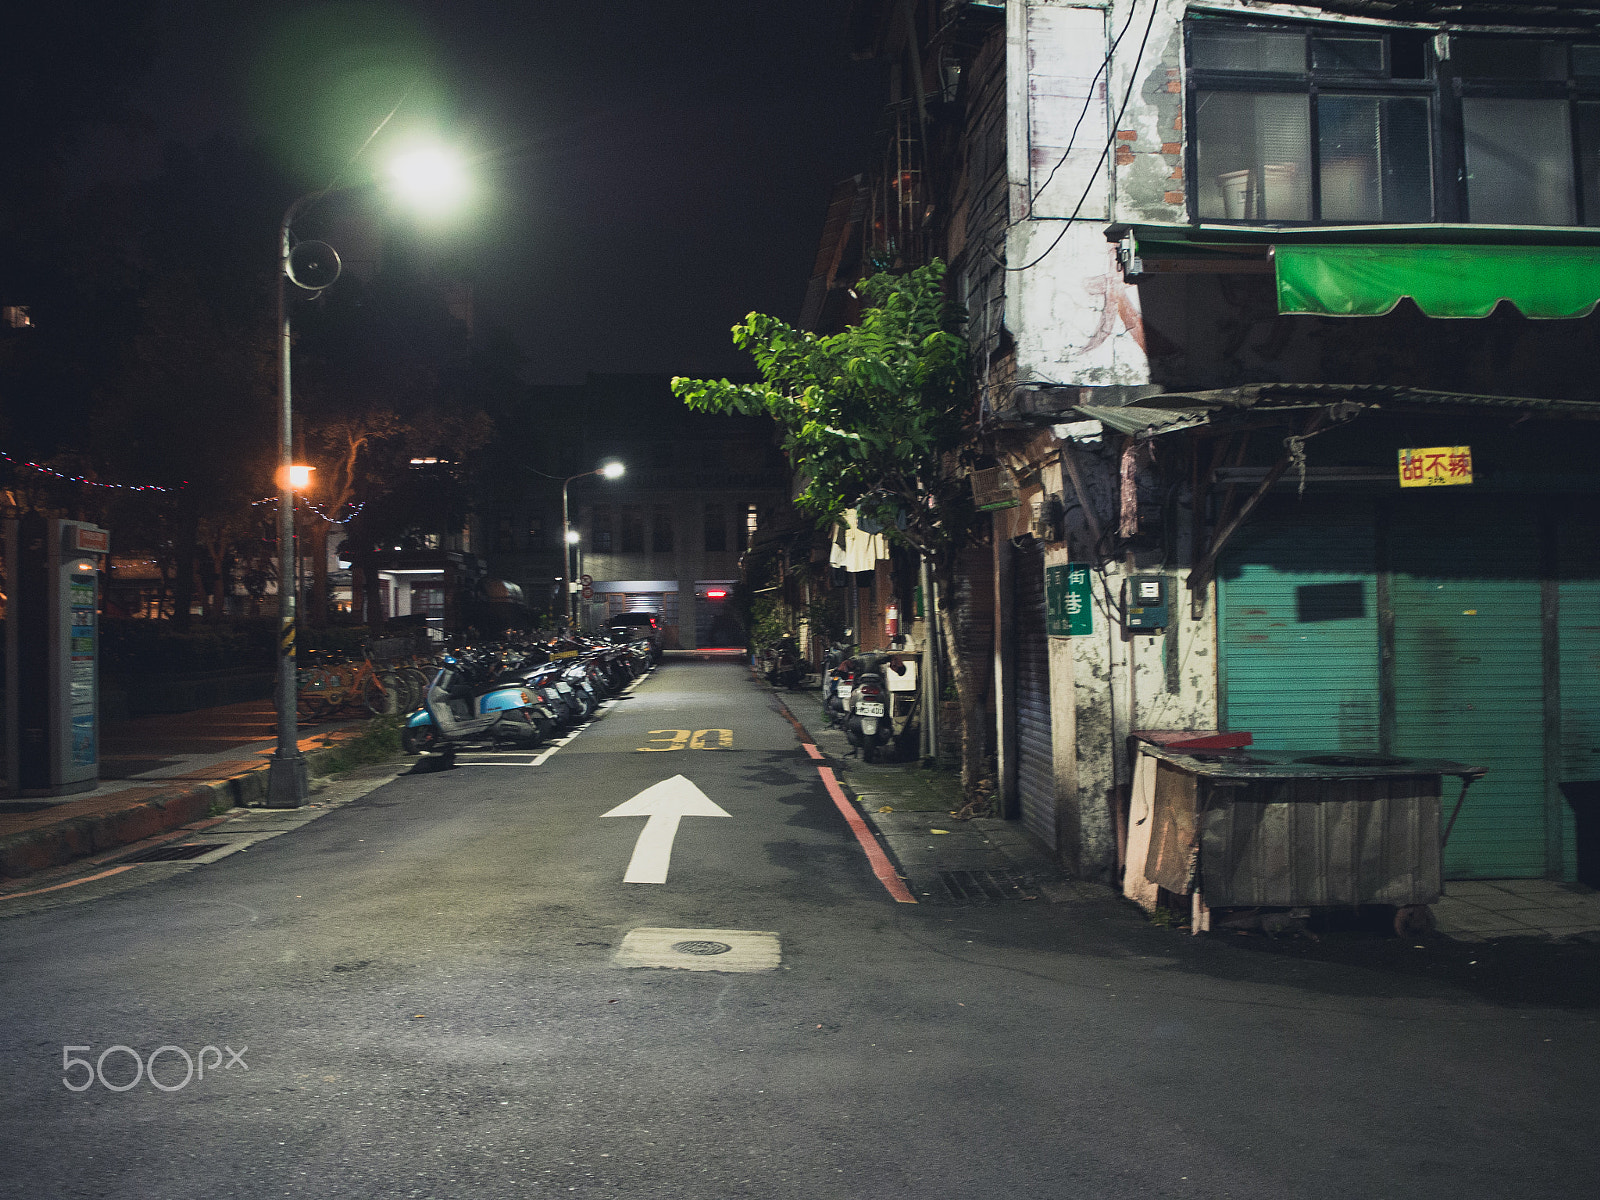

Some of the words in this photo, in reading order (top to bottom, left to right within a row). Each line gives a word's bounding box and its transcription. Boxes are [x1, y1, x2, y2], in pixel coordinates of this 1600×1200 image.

[1400, 452, 1472, 480] 甜不辣
[636, 728, 734, 752] 30
